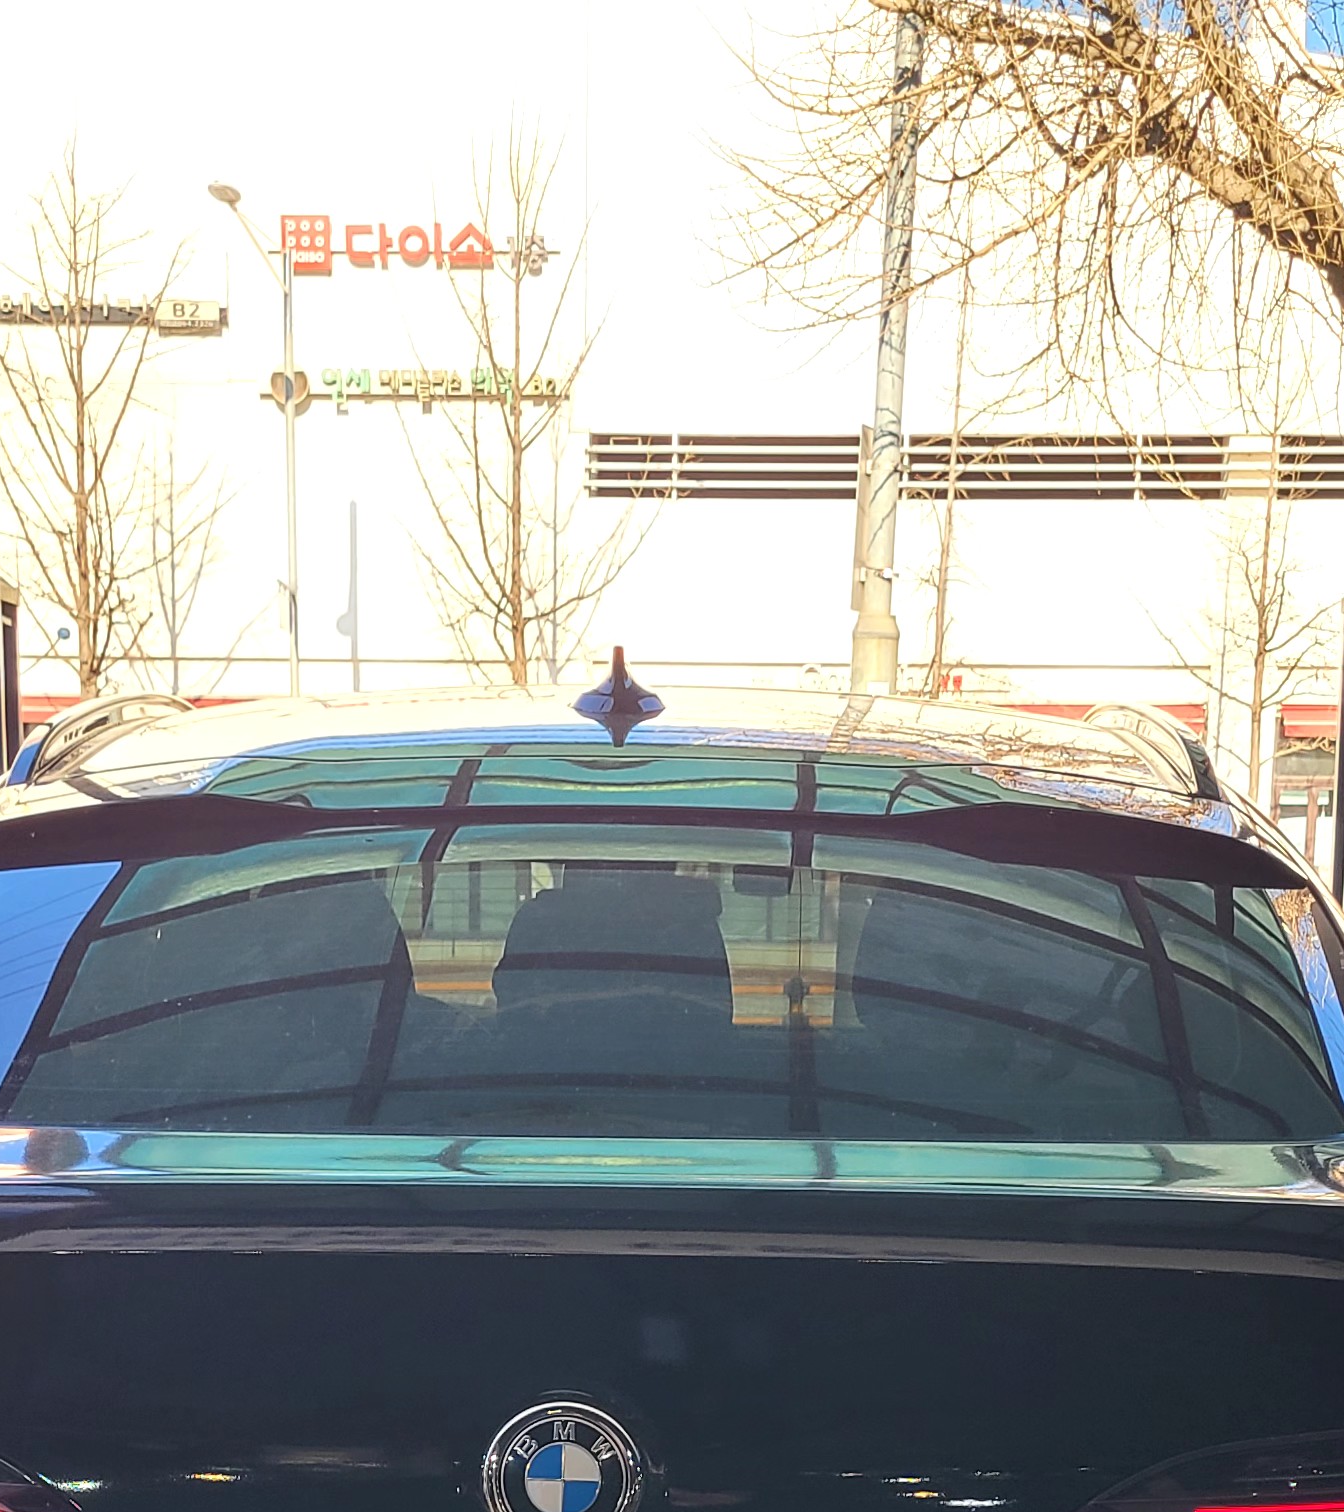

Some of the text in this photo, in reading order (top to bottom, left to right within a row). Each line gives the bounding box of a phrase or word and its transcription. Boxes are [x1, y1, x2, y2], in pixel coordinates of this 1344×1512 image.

[345, 222, 495, 269] 다이소
[172, 302, 200, 319] B2
[513, 1420, 618, 1461] BMW
